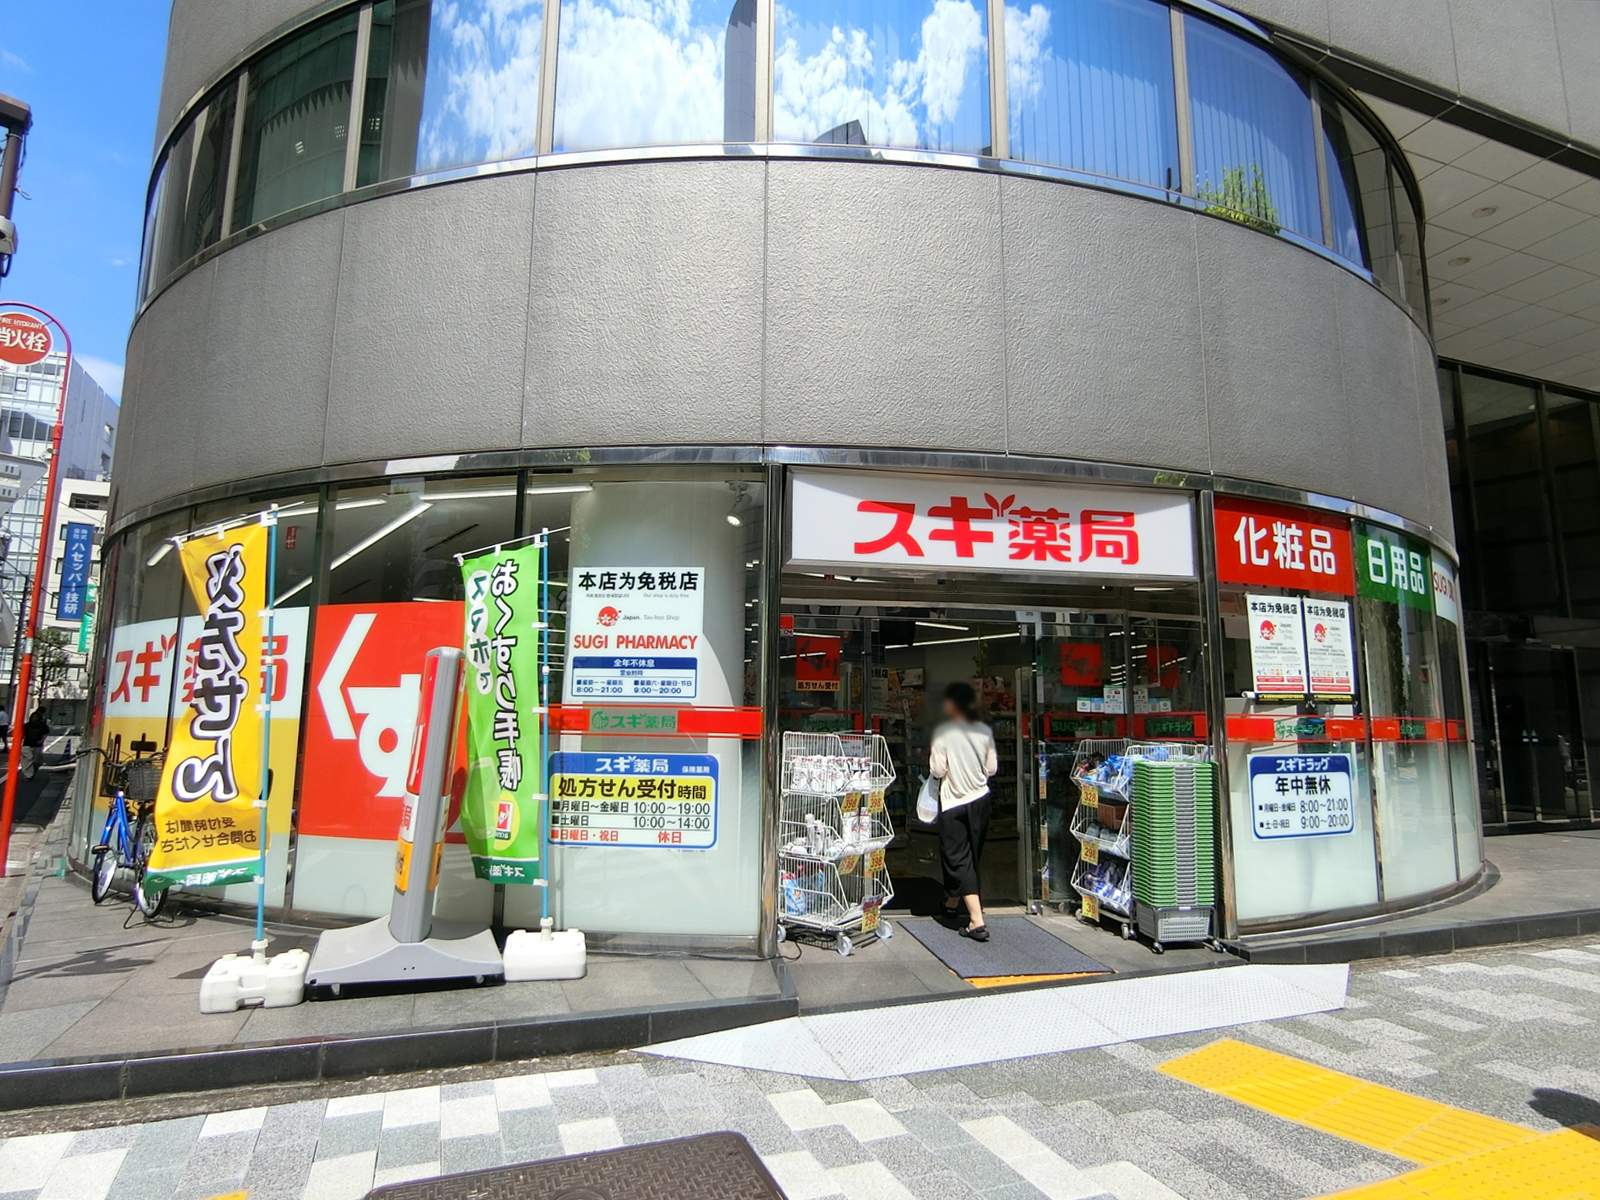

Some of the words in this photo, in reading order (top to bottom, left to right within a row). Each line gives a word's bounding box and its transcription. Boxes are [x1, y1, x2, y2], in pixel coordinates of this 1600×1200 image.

[13, 319, 43, 329] HYDRANT
[854, 492, 1140, 565] スギ薬局
[1233, 516, 1336, 575] 化粧品
[1367, 539, 1425, 595] 日用品
[578, 571, 699, 591] 本店为免税店
[1251, 602, 1298, 615] 本店为免税店
[1307, 605, 1346, 619] 本店为免税店
[573, 634, 608, 649] SUGI
[616, 635, 698, 650] PHARMACY
[613, 659, 655, 668] 全年不休息
[610, 713, 676, 729] スギ薬局
[595, 756, 669, 773] スギ薬局
[681, 766, 710, 774] 保険薬局
[1276, 757, 1330, 772] スギドラッグ
[558, 777, 706, 800] 処方せん受付時間
[1275, 775, 1331, 796] 年中無休
[844, 798, 857, 809] 398
[870, 797, 881, 808] 398
[1084, 791, 1096, 803] 328
[561, 801, 629, 813] 月曜日～金曜日
[634, 802, 710, 815] 10:00～19:00
[1300, 798, 1349, 813] 8:00～21:00
[560, 815, 589, 826] 土曜日
[633, 816, 710, 829] 10:00～14:00
[1301, 813, 1350, 829] 9:00～20:00
[658, 830, 682, 843] 休日
[1084, 847, 1096, 859] 298
[870, 856, 882, 868] 398
[865, 913, 876, 927] 298
